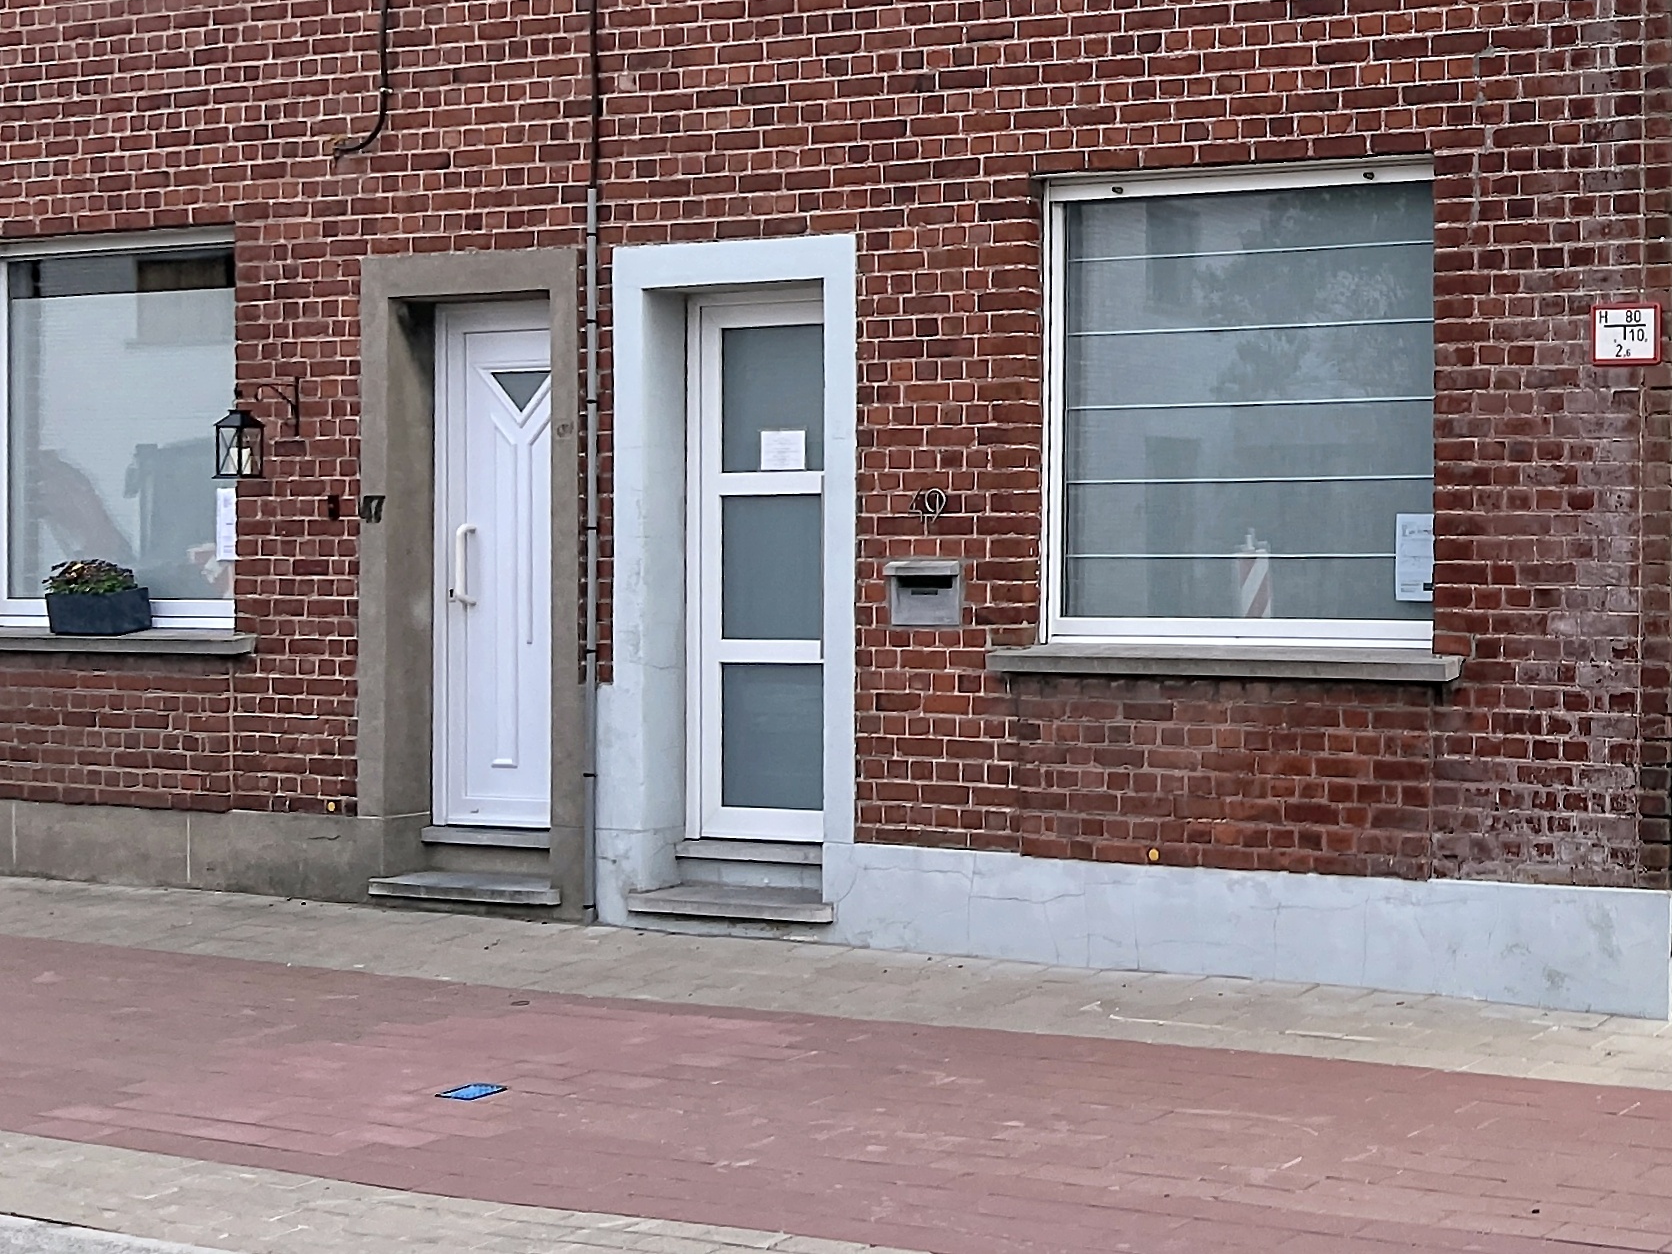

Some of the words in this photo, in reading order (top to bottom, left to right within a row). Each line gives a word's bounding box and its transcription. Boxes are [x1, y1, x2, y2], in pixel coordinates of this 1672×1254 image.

[1599, 310, 1608, 324] H
[1625, 310, 1641, 323] 80
[358, 495, 386, 524] 47
[908, 487, 947, 524] 49
